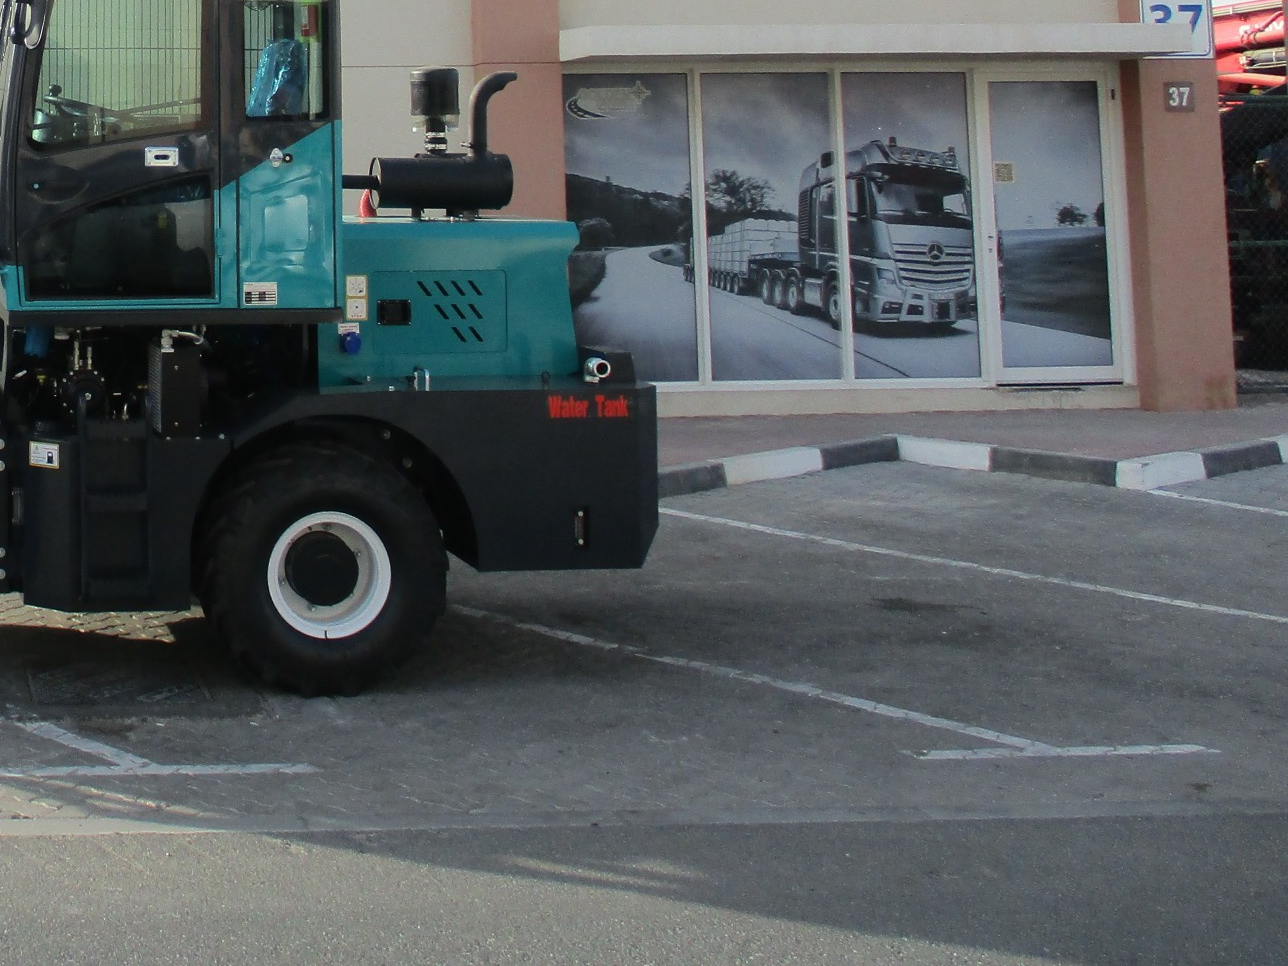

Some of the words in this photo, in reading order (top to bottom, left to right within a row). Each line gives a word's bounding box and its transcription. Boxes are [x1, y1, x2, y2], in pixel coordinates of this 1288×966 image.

[1169, 87, 1190, 106] 37
[547, 395, 589, 419] Water
[594, 394, 629, 418] Tank
